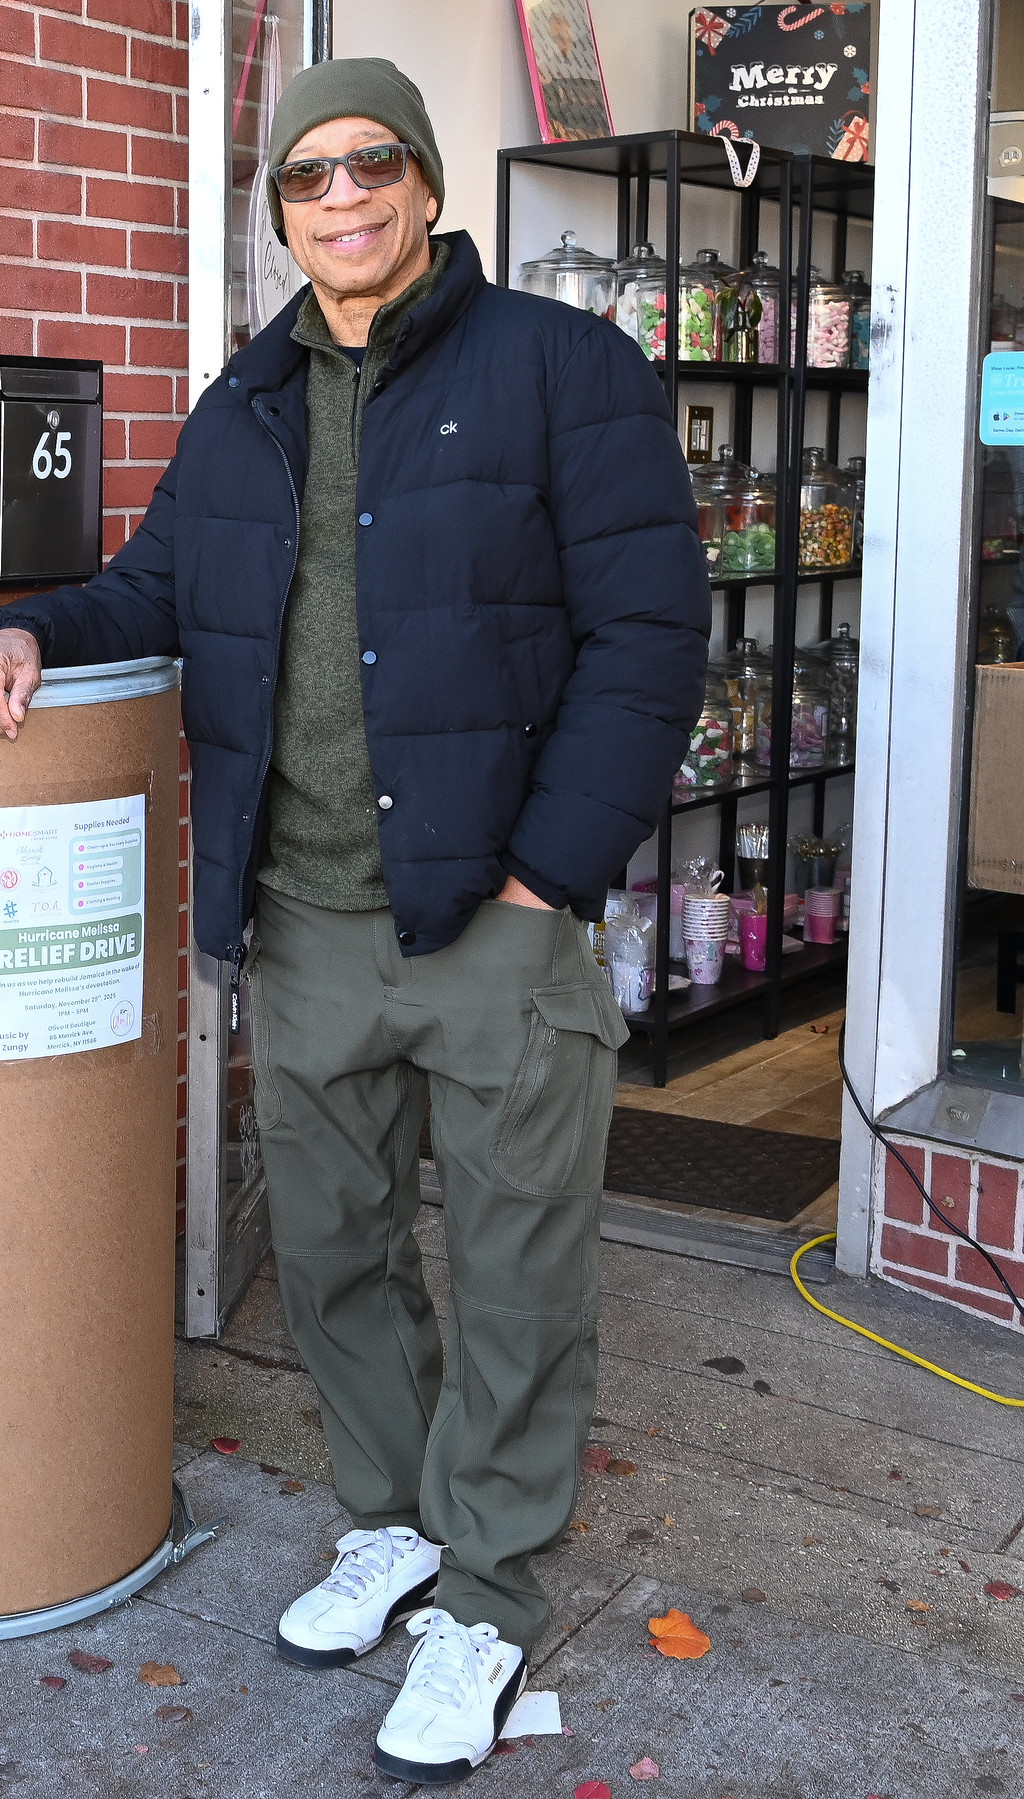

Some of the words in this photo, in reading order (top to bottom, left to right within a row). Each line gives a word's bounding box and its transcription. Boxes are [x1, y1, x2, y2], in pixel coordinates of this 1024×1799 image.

[729, 61, 838, 92] Merry
[736, 94, 825, 108] Christmas
[264, 241, 288, 299] Closed
[440, 420, 458, 435] ck
[32, 432, 72, 479] 65
[74, 821, 105, 831] Supplies
[106, 817, 130, 827] Needed
[9, 828, 58, 837] HOMESMART
[18, 928, 79, 943] Hurricane
[81, 921, 120, 938] Melissa
[80, 933, 136, 962] DRIVE
[38, 978, 53, 986] help
[79, 972, 104, 981] Jamaica
[54, 985, 84, 993] Melissa's
[86, 978, 120, 990] devastation.
[24, 1003, 57, 1011] Saturday,
[59, 997, 90, 1007] November
[70, 1020, 96, 1029] Boutique
[18, 1031, 29, 1040] by
[2, 1044, 29, 1052] Zungy
[47, 1041, 72, 1050] Merrick,
